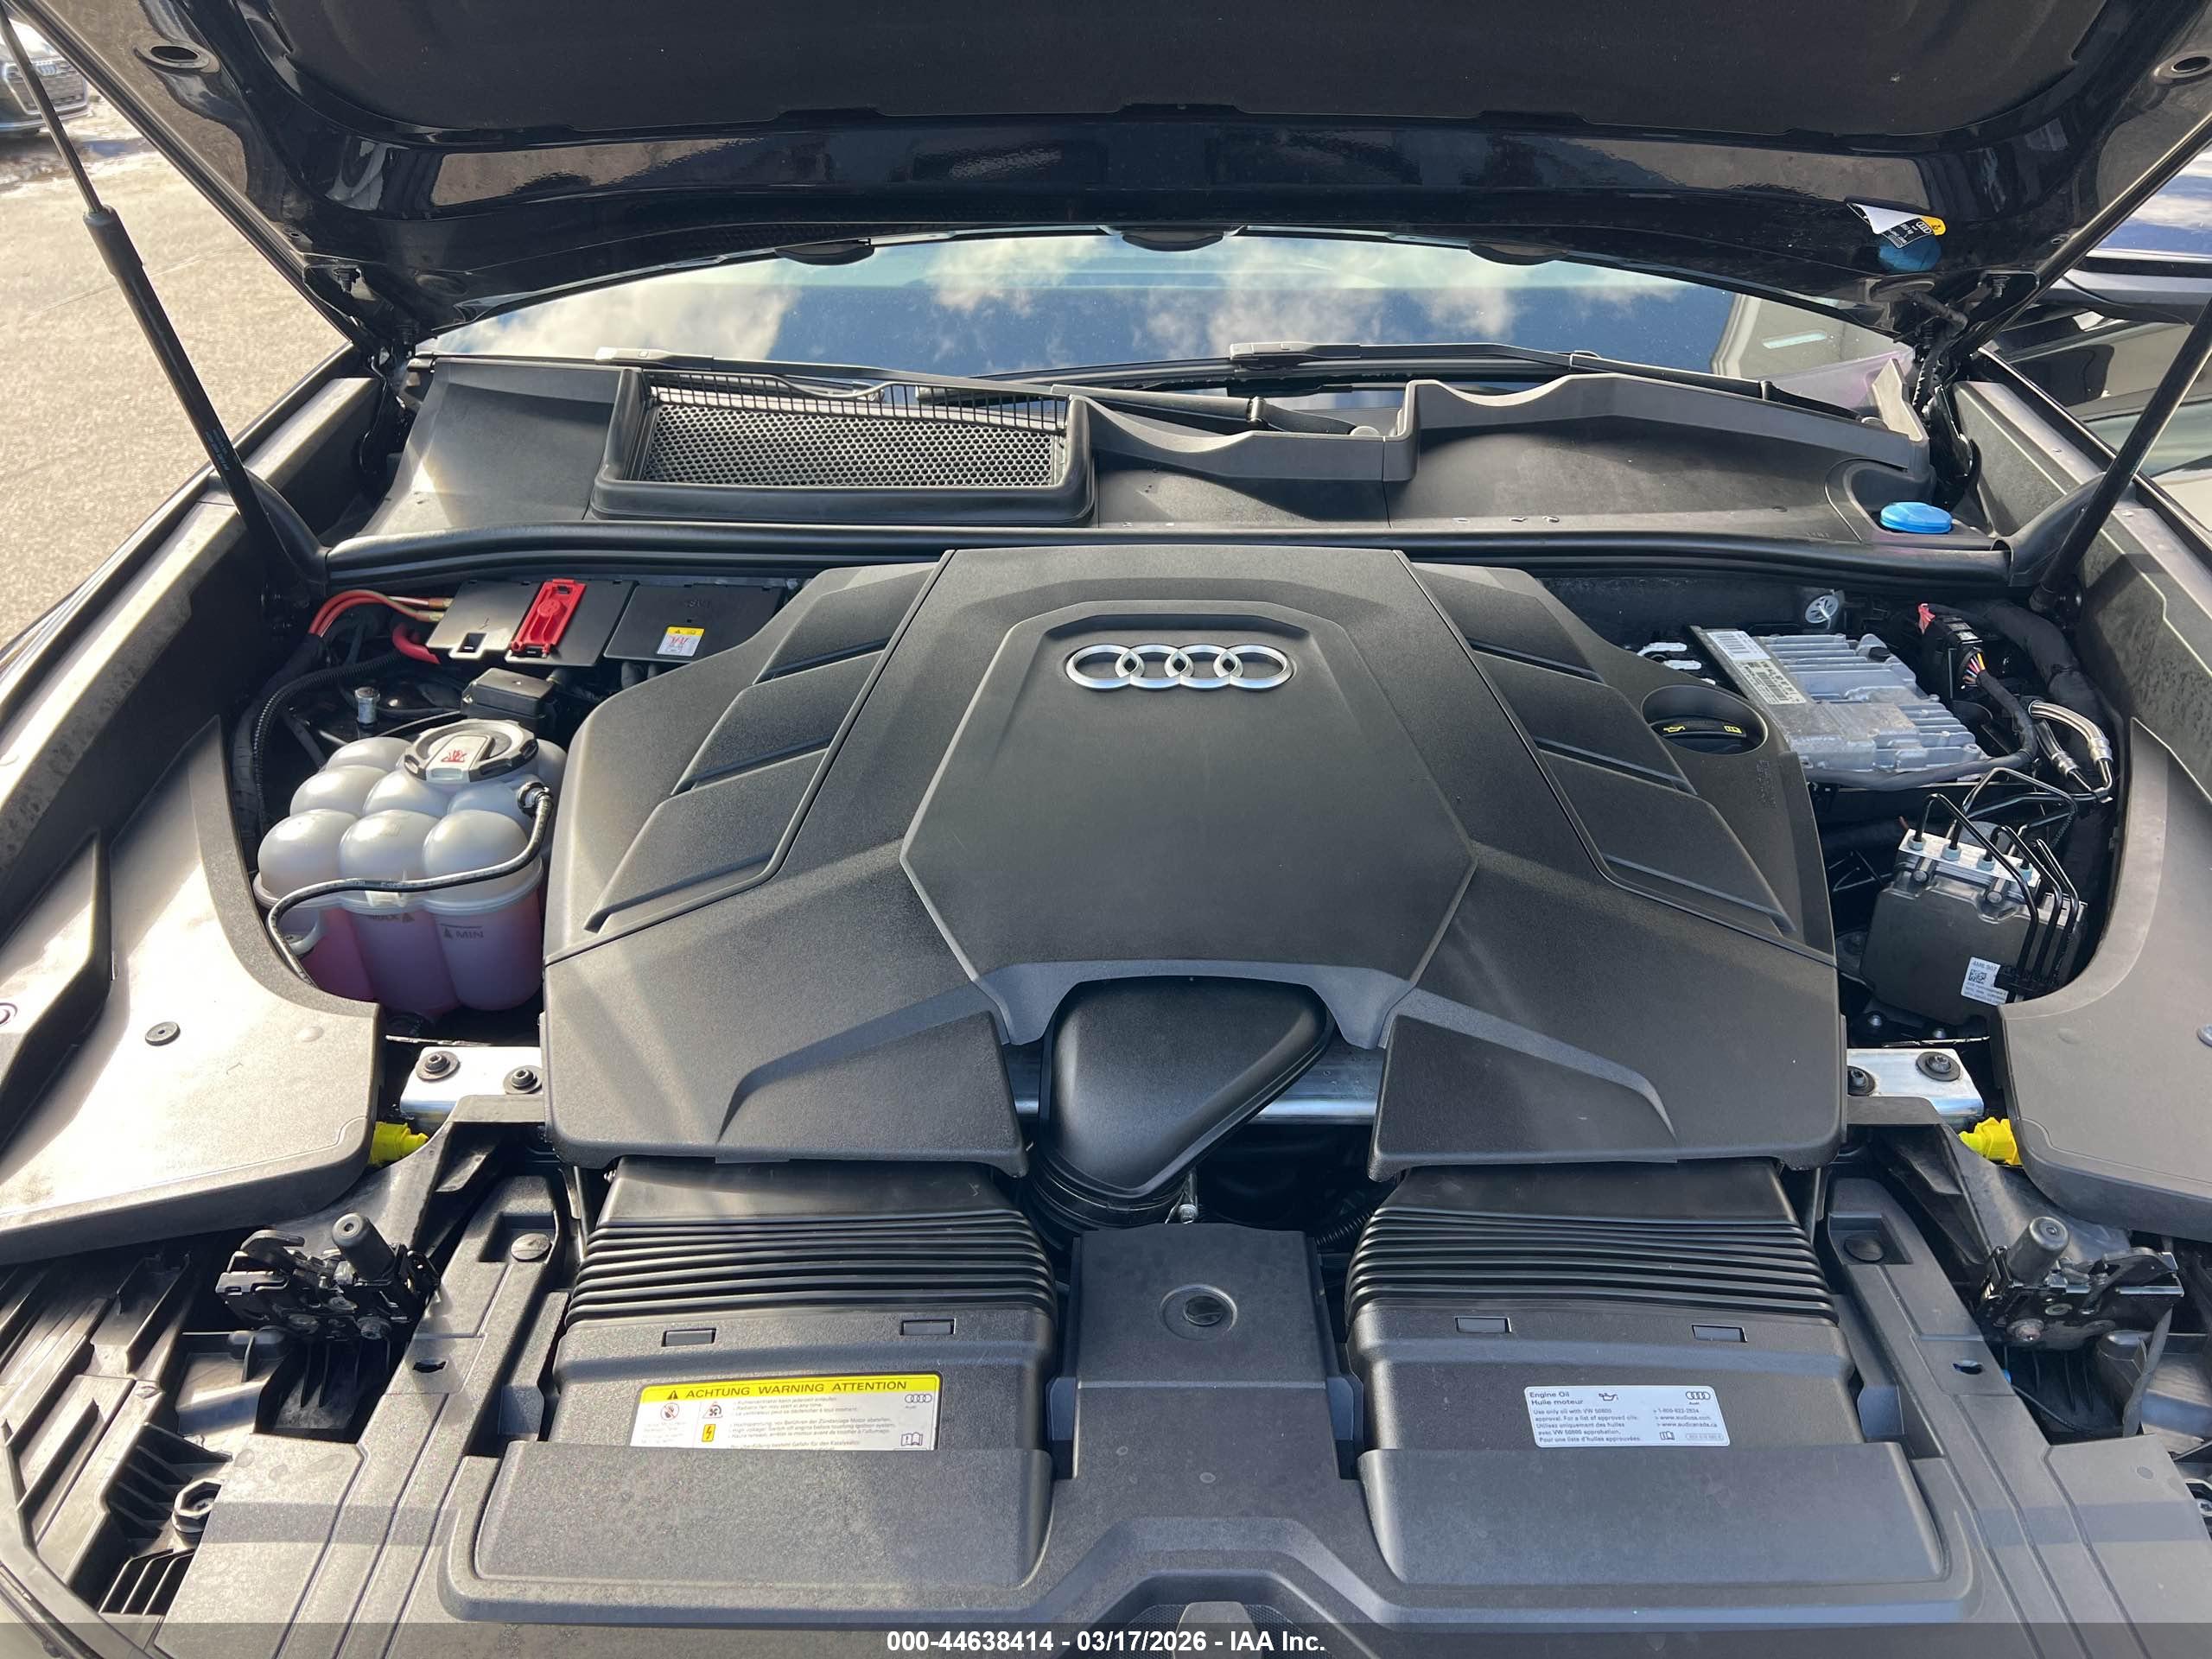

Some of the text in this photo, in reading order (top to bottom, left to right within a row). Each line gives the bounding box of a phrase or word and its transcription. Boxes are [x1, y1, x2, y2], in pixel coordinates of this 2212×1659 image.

[455, 930, 484, 938] MIN
[685, 1381, 906, 1398] ACHTUNG WARNING ATTENTION
